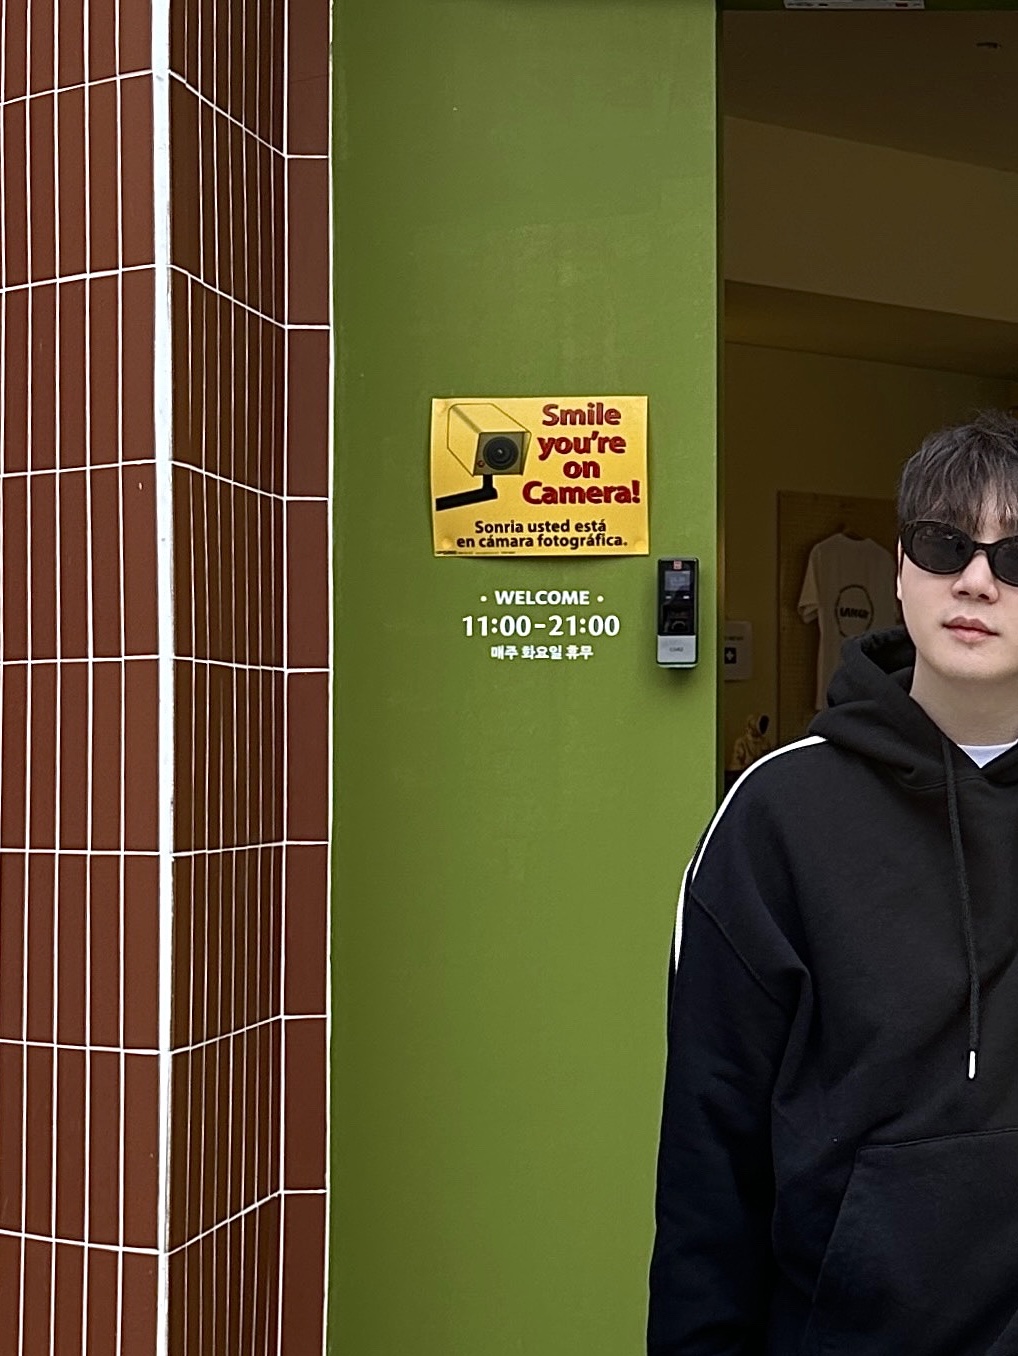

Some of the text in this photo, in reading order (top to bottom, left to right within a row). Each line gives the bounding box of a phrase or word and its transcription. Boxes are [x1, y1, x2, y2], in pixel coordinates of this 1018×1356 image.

[542, 402, 622, 426] Smile
[537, 431, 627, 461] you're
[563, 460, 600, 479] on
[522, 480, 641, 505] Camera!
[475, 519, 607, 534] Sonria usted está
[456, 533, 628, 550] en cámara fotográfica.
[494, 590, 590, 605] WELCOME
[490, 645, 594, 660] 매주 화요일 휴무
